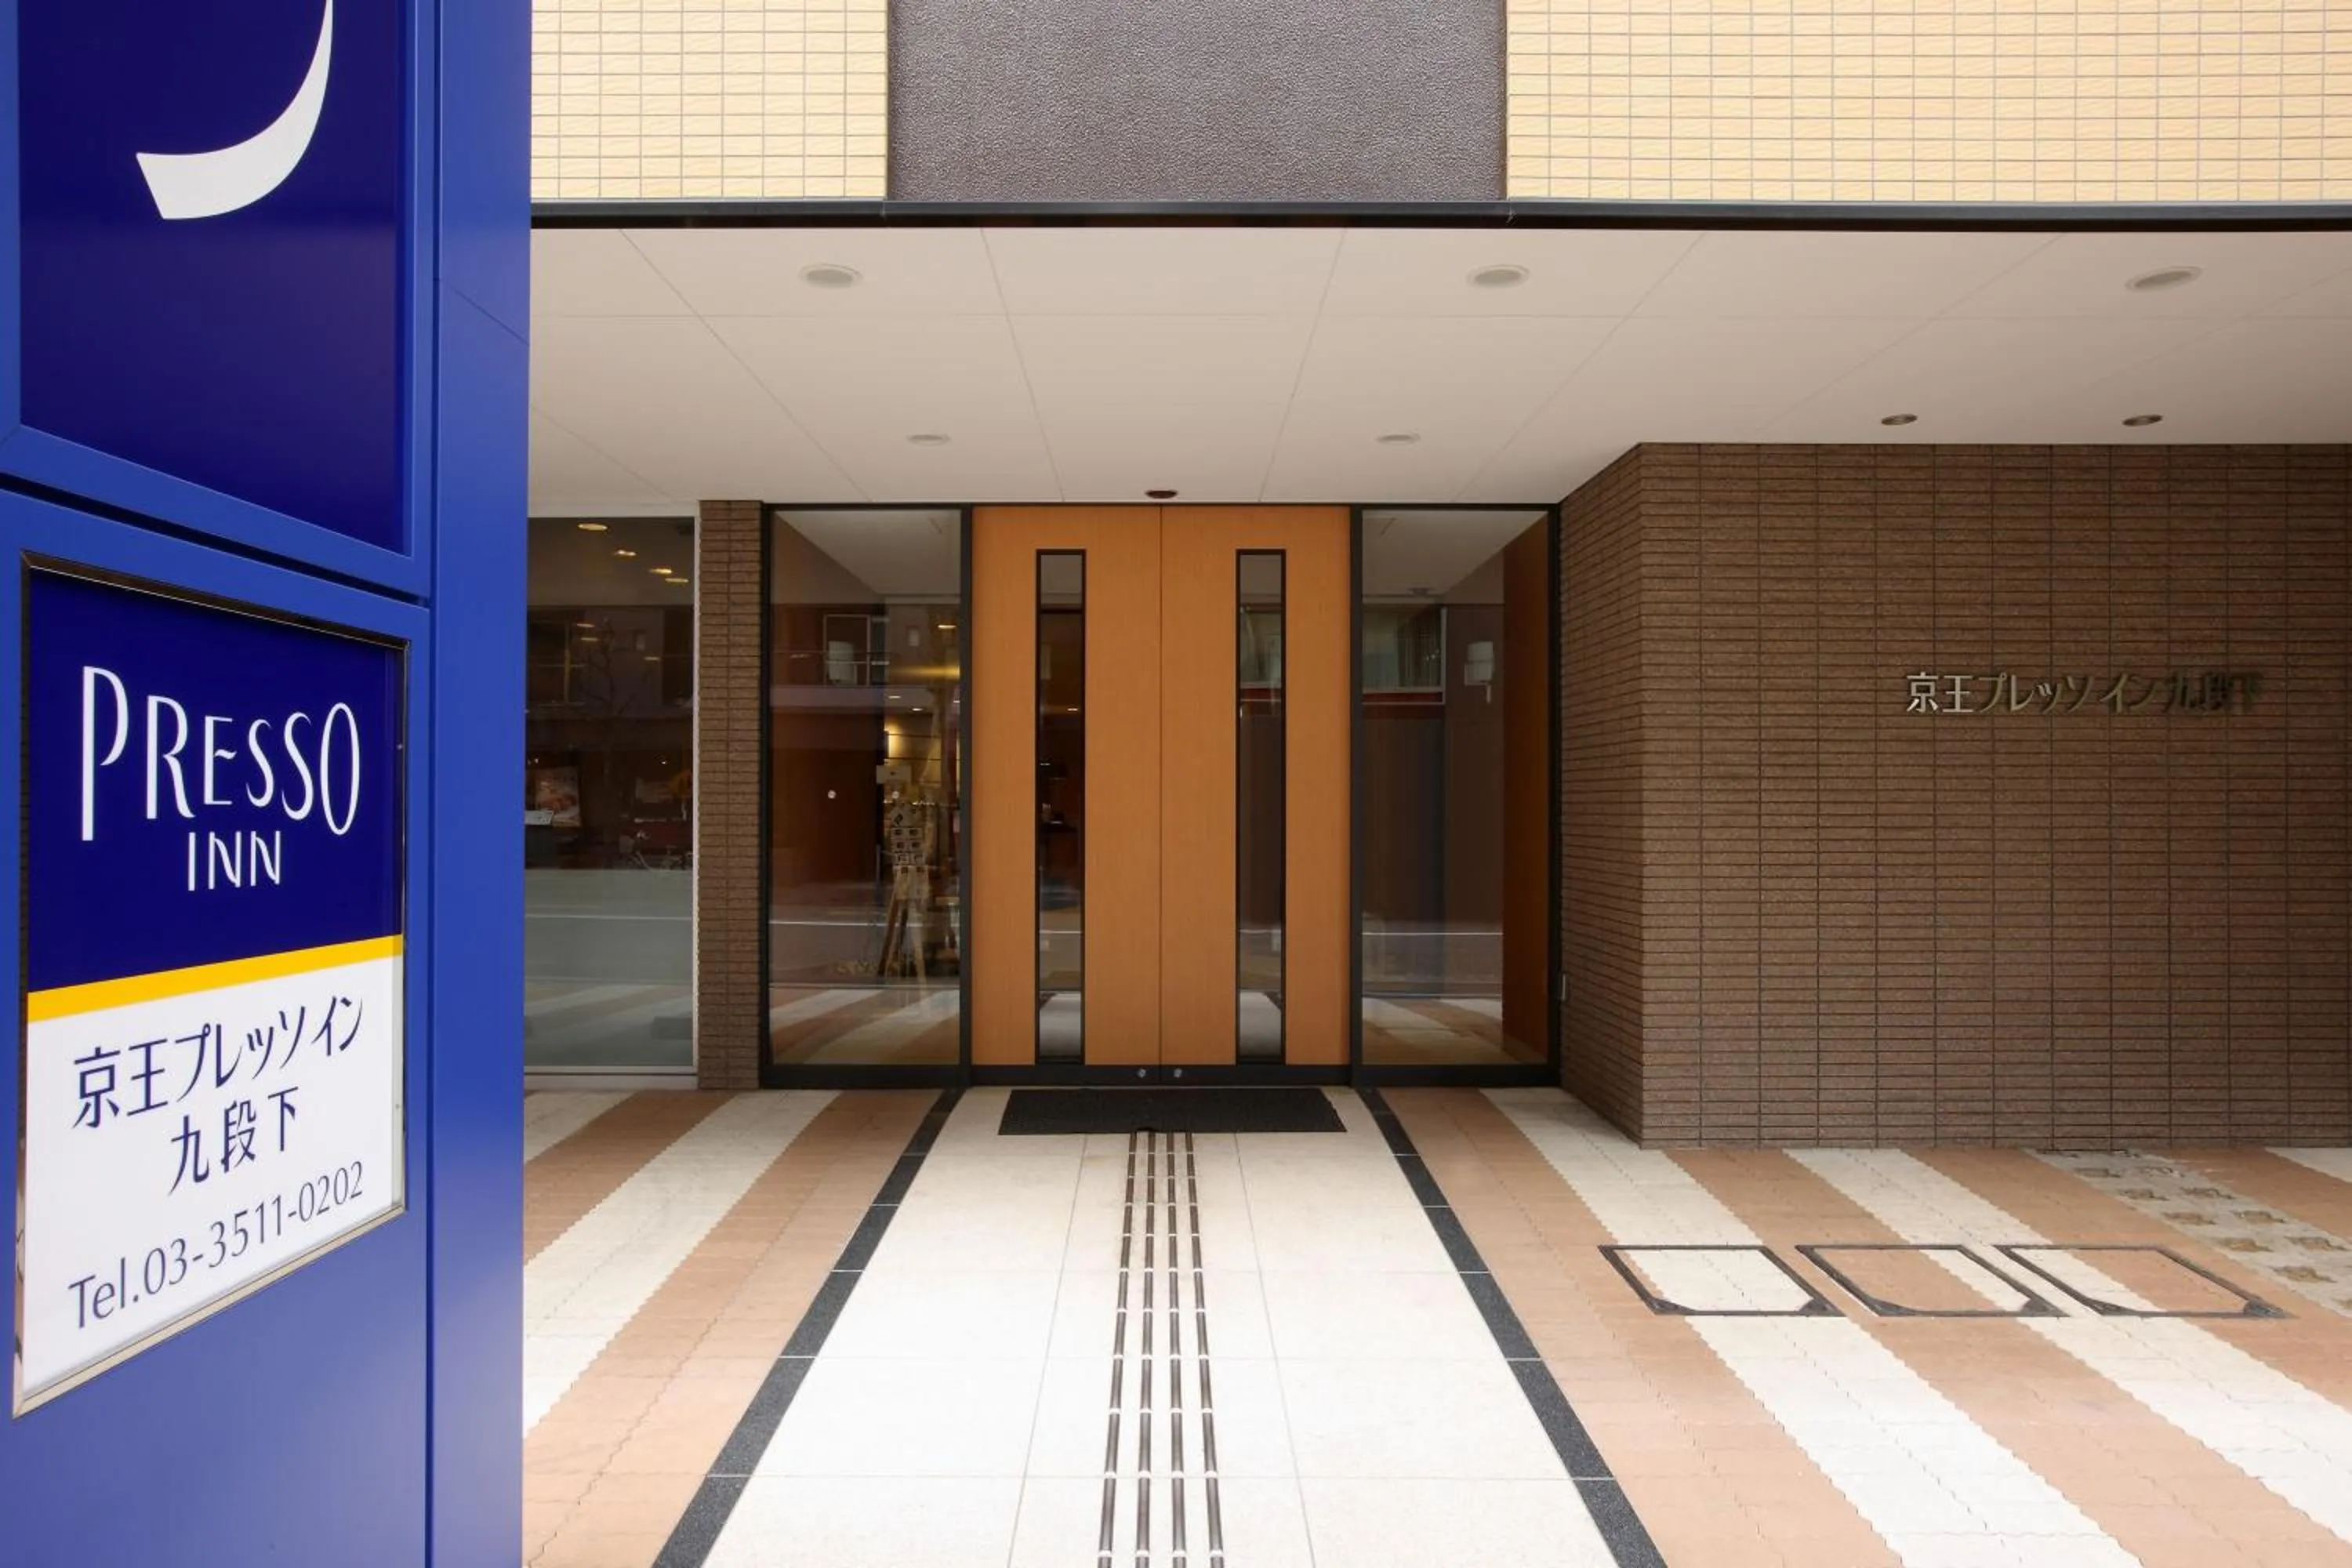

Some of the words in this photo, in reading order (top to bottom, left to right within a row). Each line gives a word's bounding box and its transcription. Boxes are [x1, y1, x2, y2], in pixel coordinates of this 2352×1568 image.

[82, 666, 360, 841] PRESSO
[187, 830, 281, 891] INN
[72, 996, 363, 1129] 京王プレッソイン
[168, 1086, 299, 1196] 九段下
